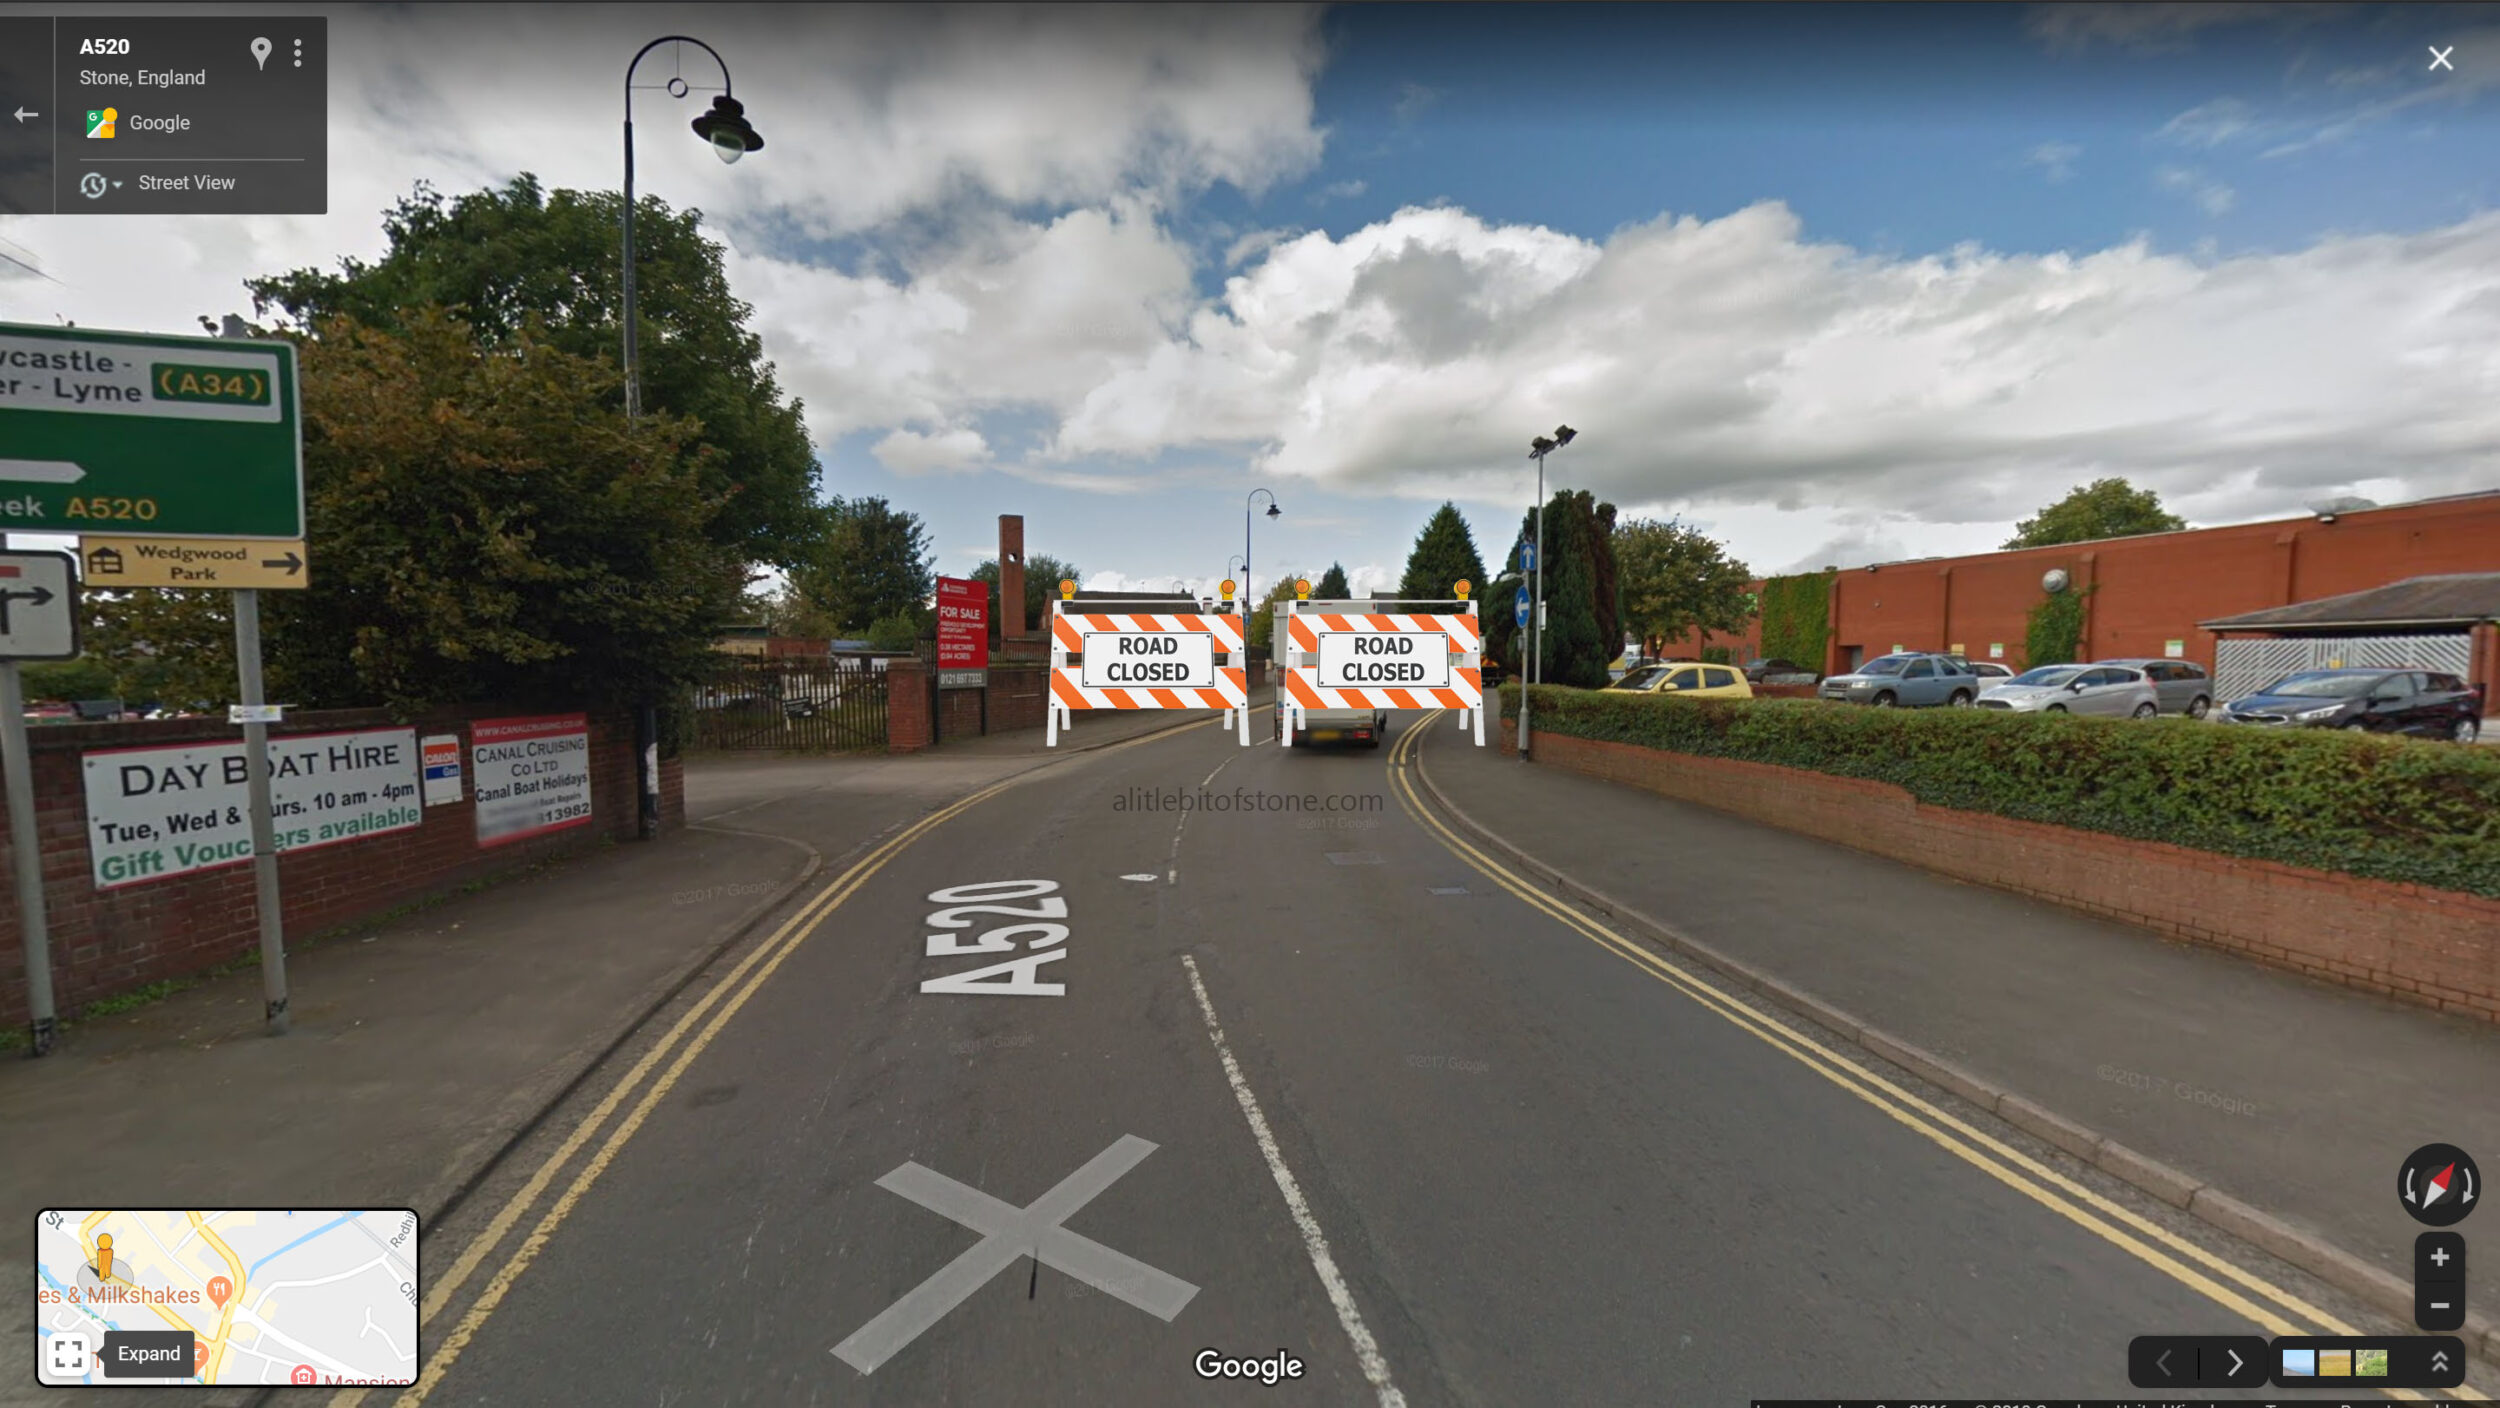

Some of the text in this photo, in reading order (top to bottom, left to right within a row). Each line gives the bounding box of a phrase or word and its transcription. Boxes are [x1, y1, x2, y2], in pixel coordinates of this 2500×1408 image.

[53, 376, 143, 404] Lyme
[159, 368, 264, 400] (A34)
[0, 495, 158, 521] ek A520
[134, 544, 248, 563] Wedgwood
[170, 566, 217, 582] Park
[940, 605, 981, 620] FOR SALE
[1118, 637, 1179, 656] ROAD
[1353, 637, 1414, 656] ROAD
[1106, 663, 1191, 682] CLOSED
[1341, 663, 1426, 682] CLOSED
[475, 738, 586, 764] CANAL CRUISING
[119, 762, 210, 798] DAY
[327, 743, 400, 773] HIRE
[475, 773, 588, 803] Canal Boat Holidays
[99, 822, 160, 845] Tue,
[166, 808, 218, 835] Wed
[225, 806, 242, 825] &
[313, 791, 336, 811] 10
[341, 790, 368, 807] am
[381, 783, 415, 802] 4pm
[101, 805, 419, 882] Gift Voucers available
